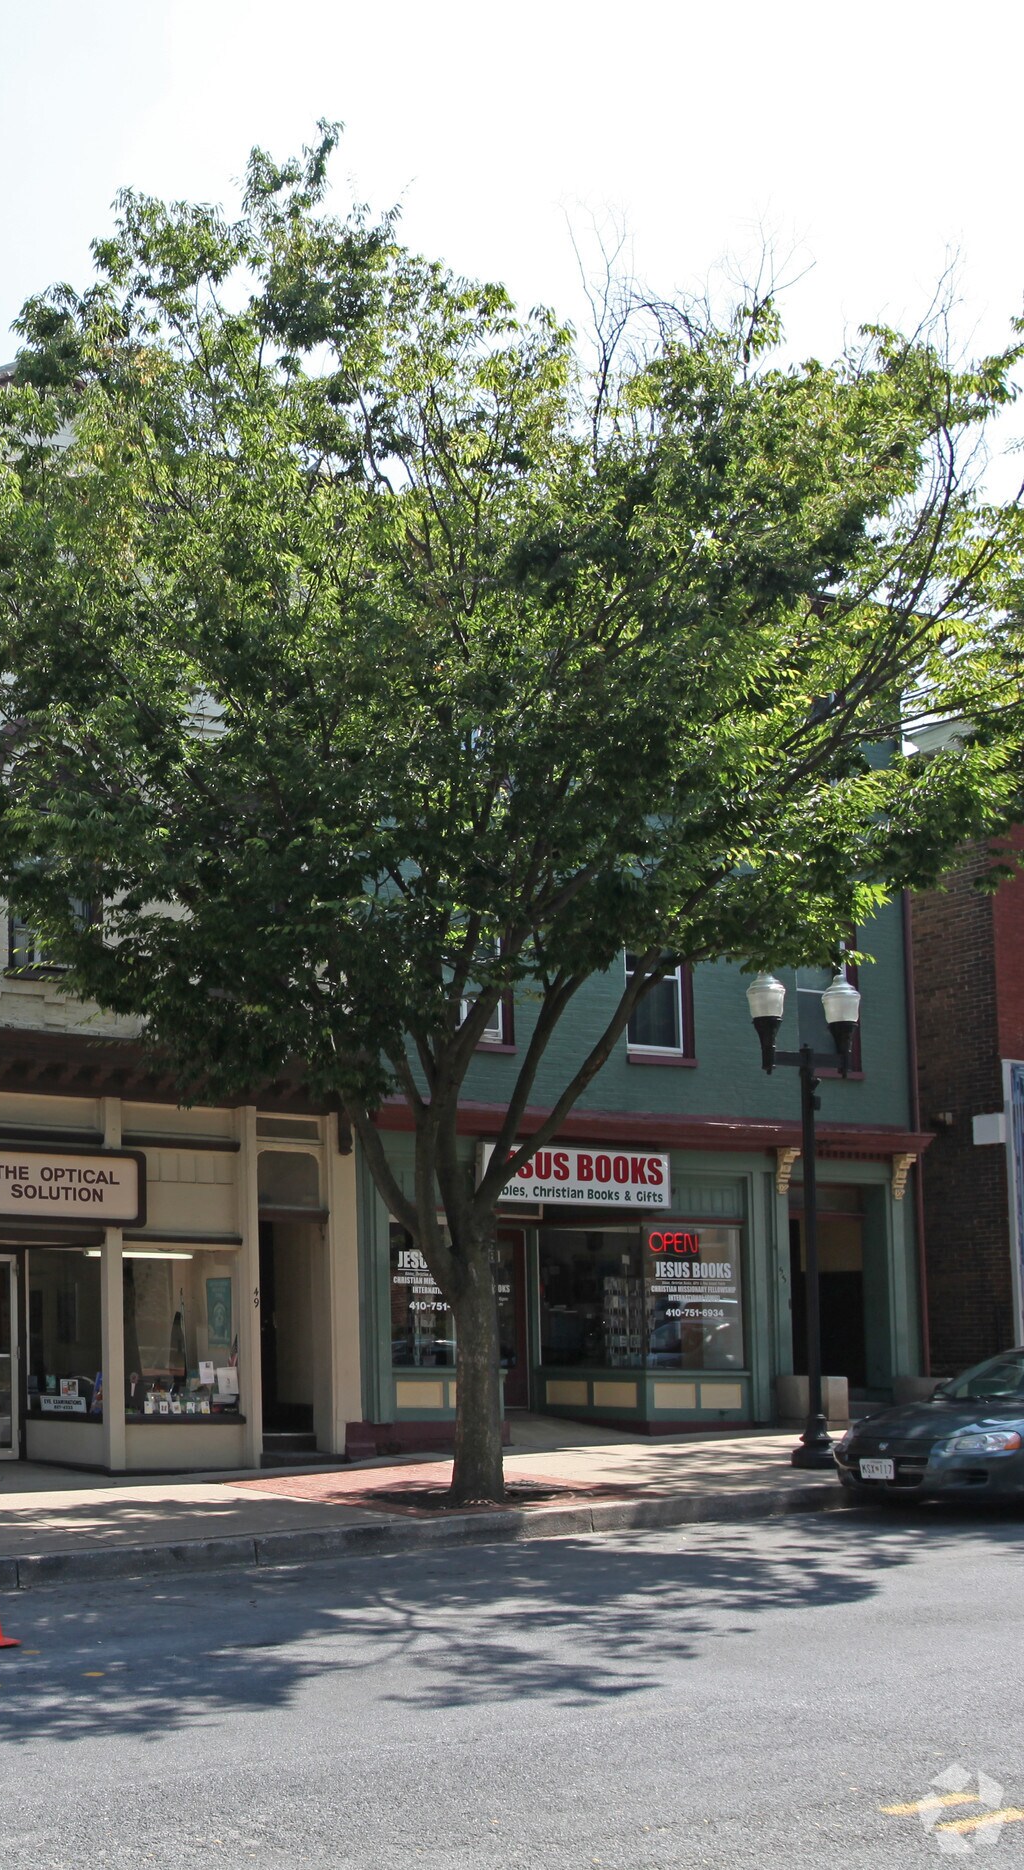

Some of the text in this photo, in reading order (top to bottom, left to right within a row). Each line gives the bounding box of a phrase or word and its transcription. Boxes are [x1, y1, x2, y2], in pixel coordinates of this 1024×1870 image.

[40, 1167, 120, 1185] OPTICAL
[506, 1150, 664, 1185] SUS BOOKS
[11, 1184, 104, 1202] SOLUTION
[501, 1185, 663, 1203] bles, Christian Books & Gifts
[648, 1232, 699, 1253] OPEN
[397, 1251, 428, 1269] JESU
[655, 1261, 732, 1278] JESUS BOOKS
[393, 1276, 423, 1285] CHRISTIAN
[497, 1284, 511, 1293] OKS
[650, 1285, 736, 1294] CHRISTIAN MISSIONARY FELLOWSHIP
[409, 1301, 451, 1311] 410-751-
[665, 1308, 724, 1317] 410-751-6934
